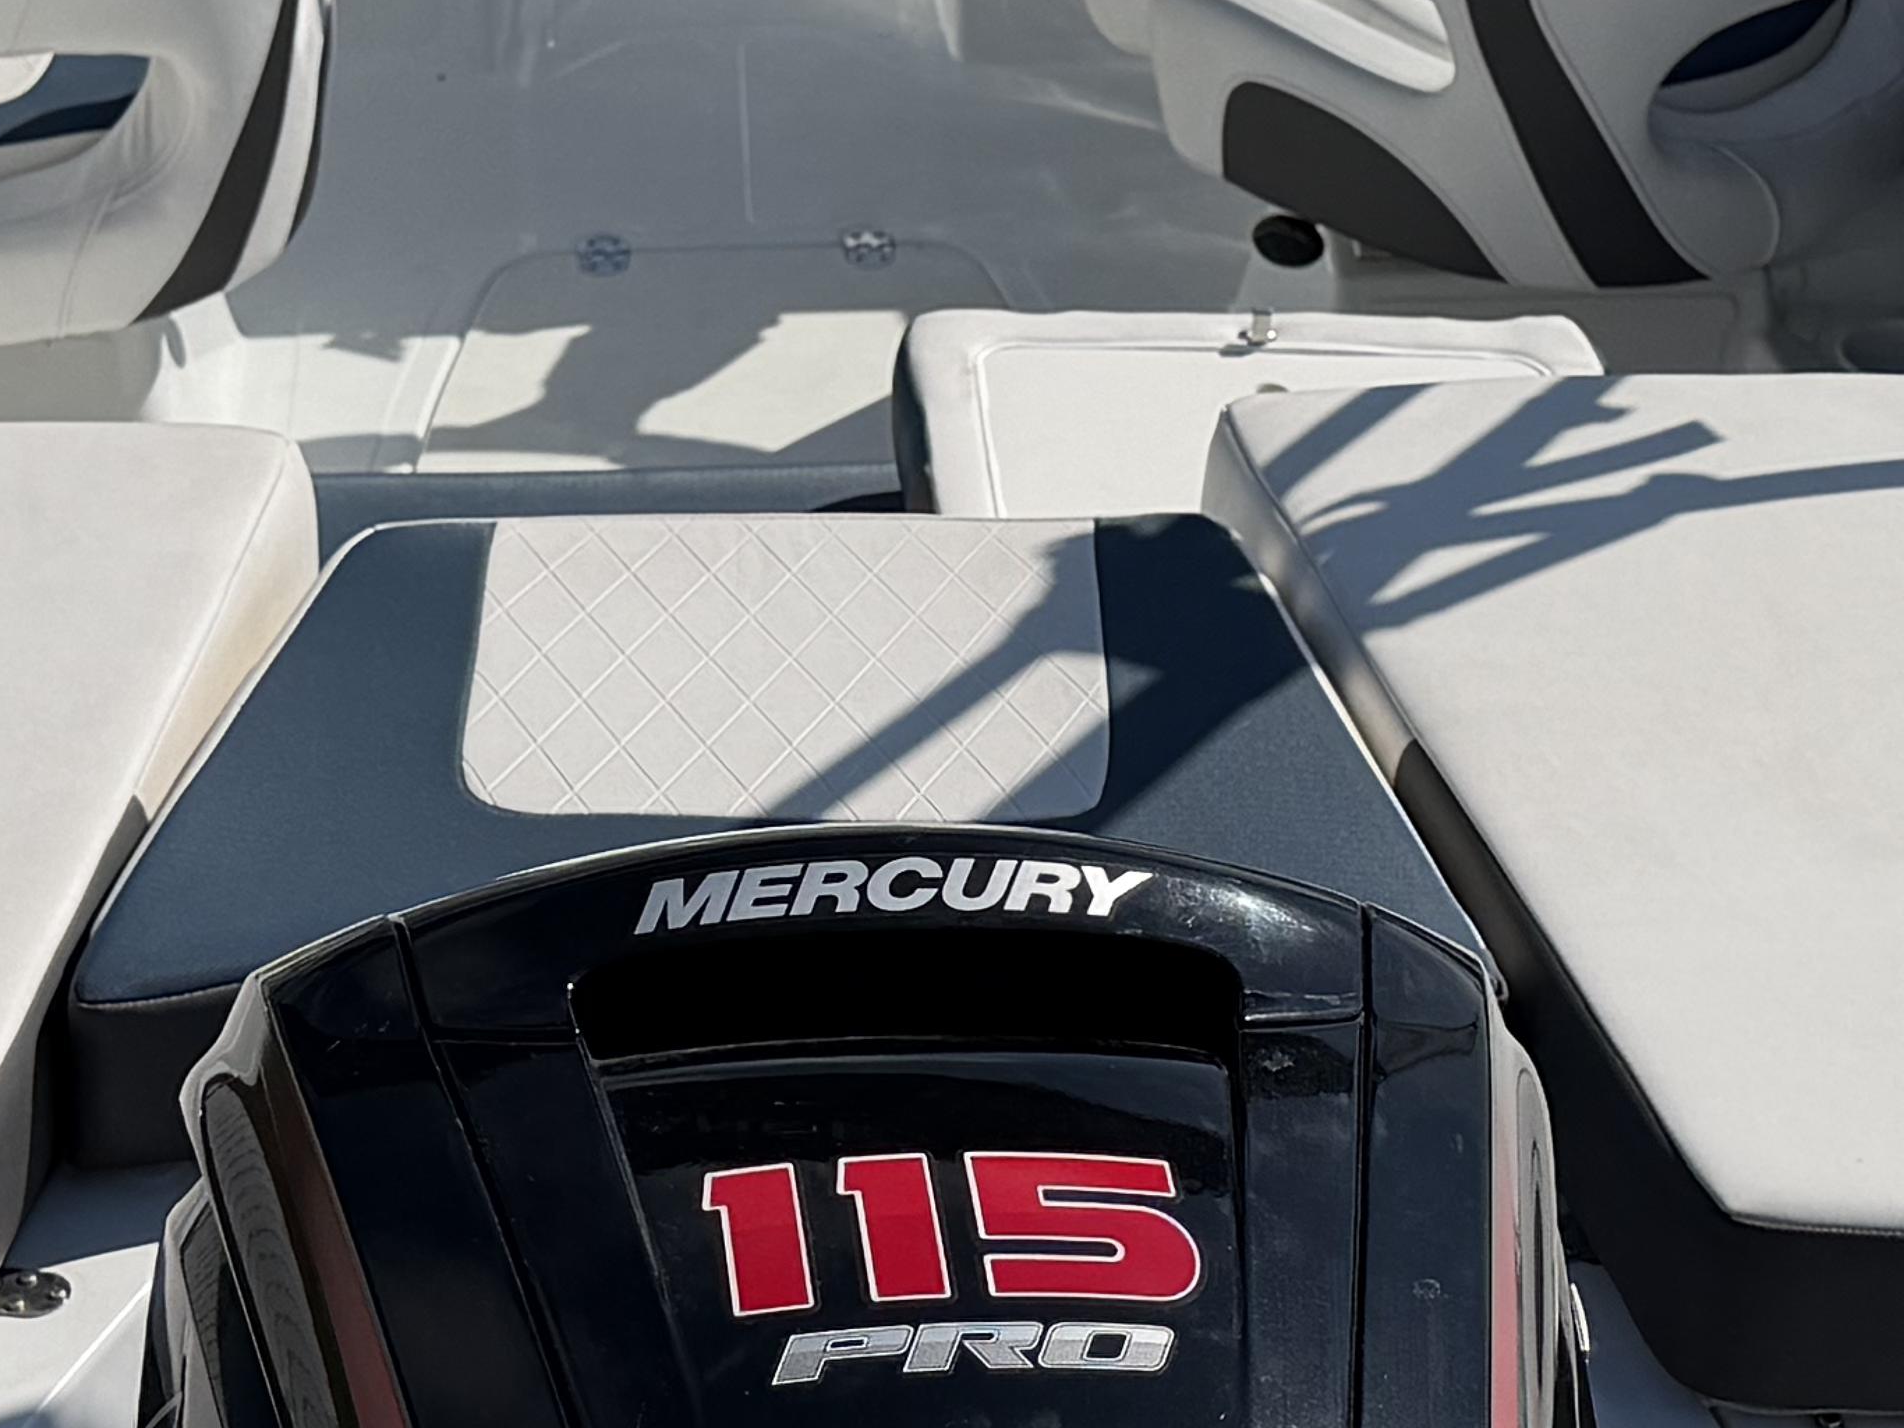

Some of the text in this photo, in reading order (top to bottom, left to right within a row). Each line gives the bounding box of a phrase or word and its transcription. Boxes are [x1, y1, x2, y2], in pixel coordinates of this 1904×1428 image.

[633, 857, 1153, 935] MERCURY
[700, 1150, 1202, 1317] 115
[771, 1322, 1175, 1386] PRO
